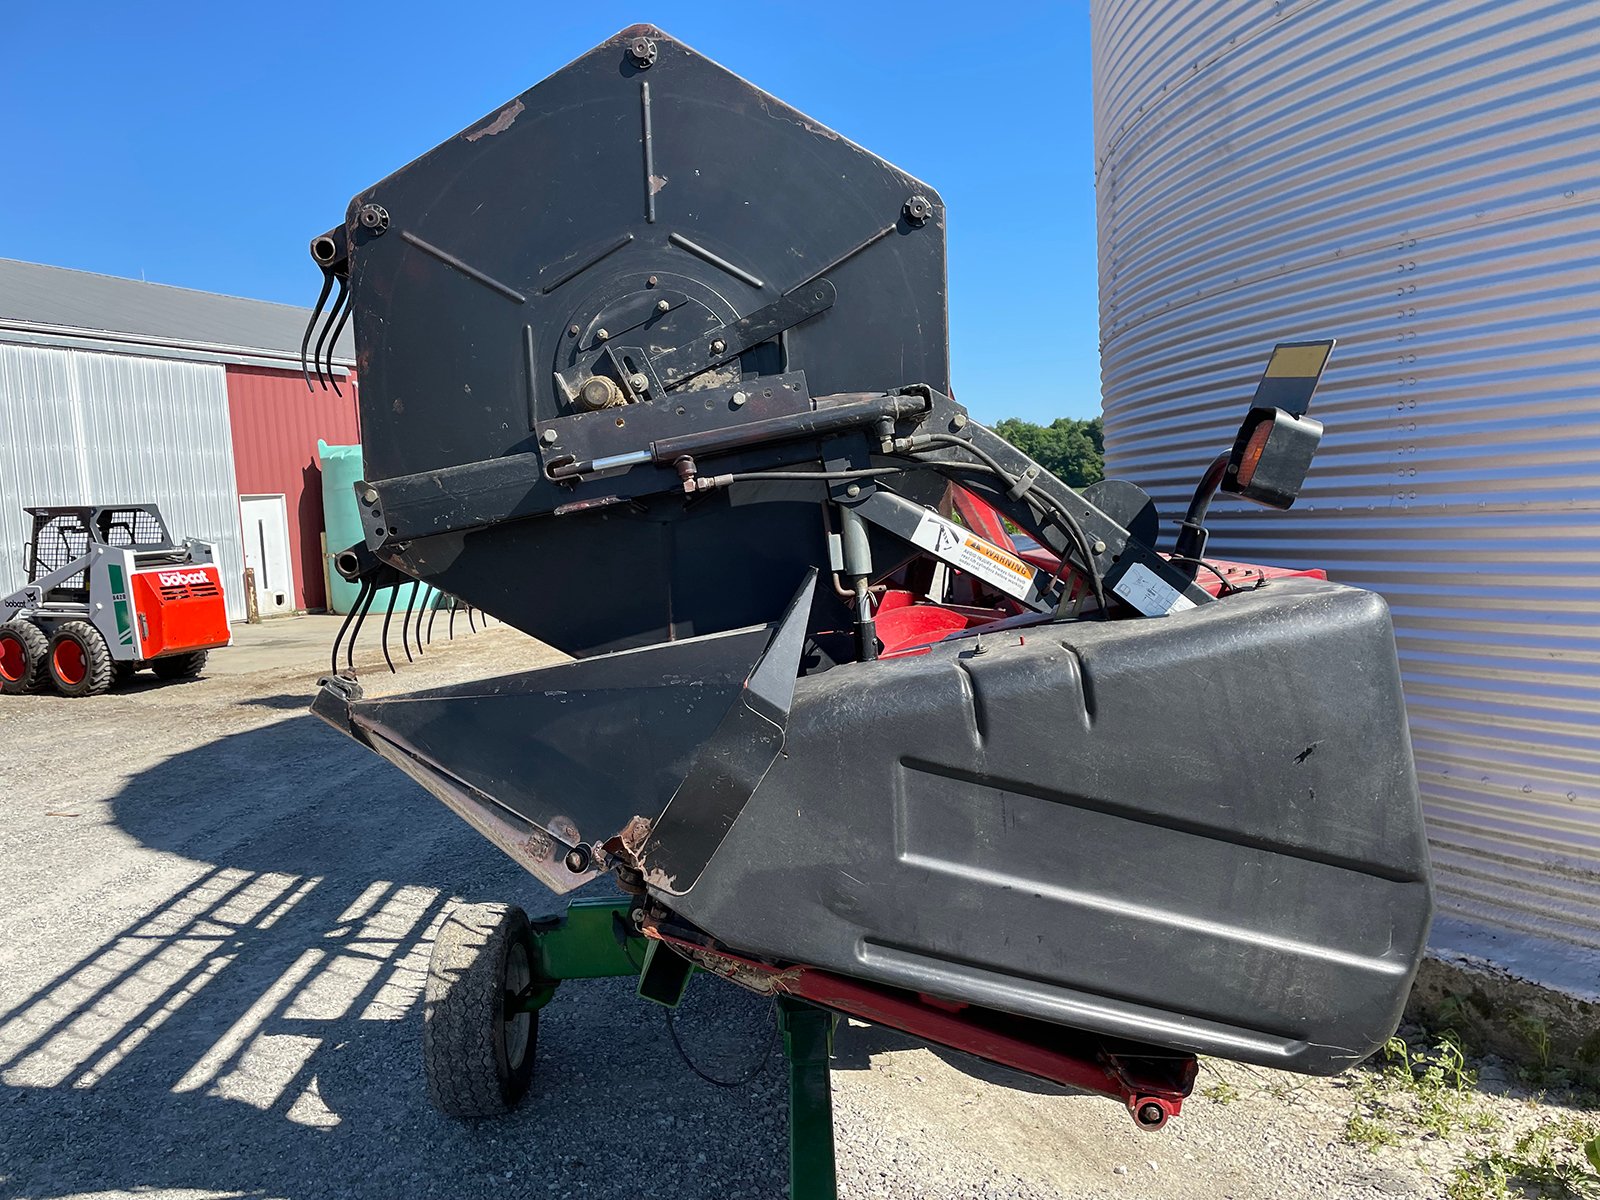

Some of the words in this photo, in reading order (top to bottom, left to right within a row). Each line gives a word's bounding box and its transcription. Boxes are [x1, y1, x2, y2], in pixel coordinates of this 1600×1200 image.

[985, 548, 1027, 575] WARNING
[158, 570, 209, 586] bobcat
[5, 600, 26, 608] bobcat
